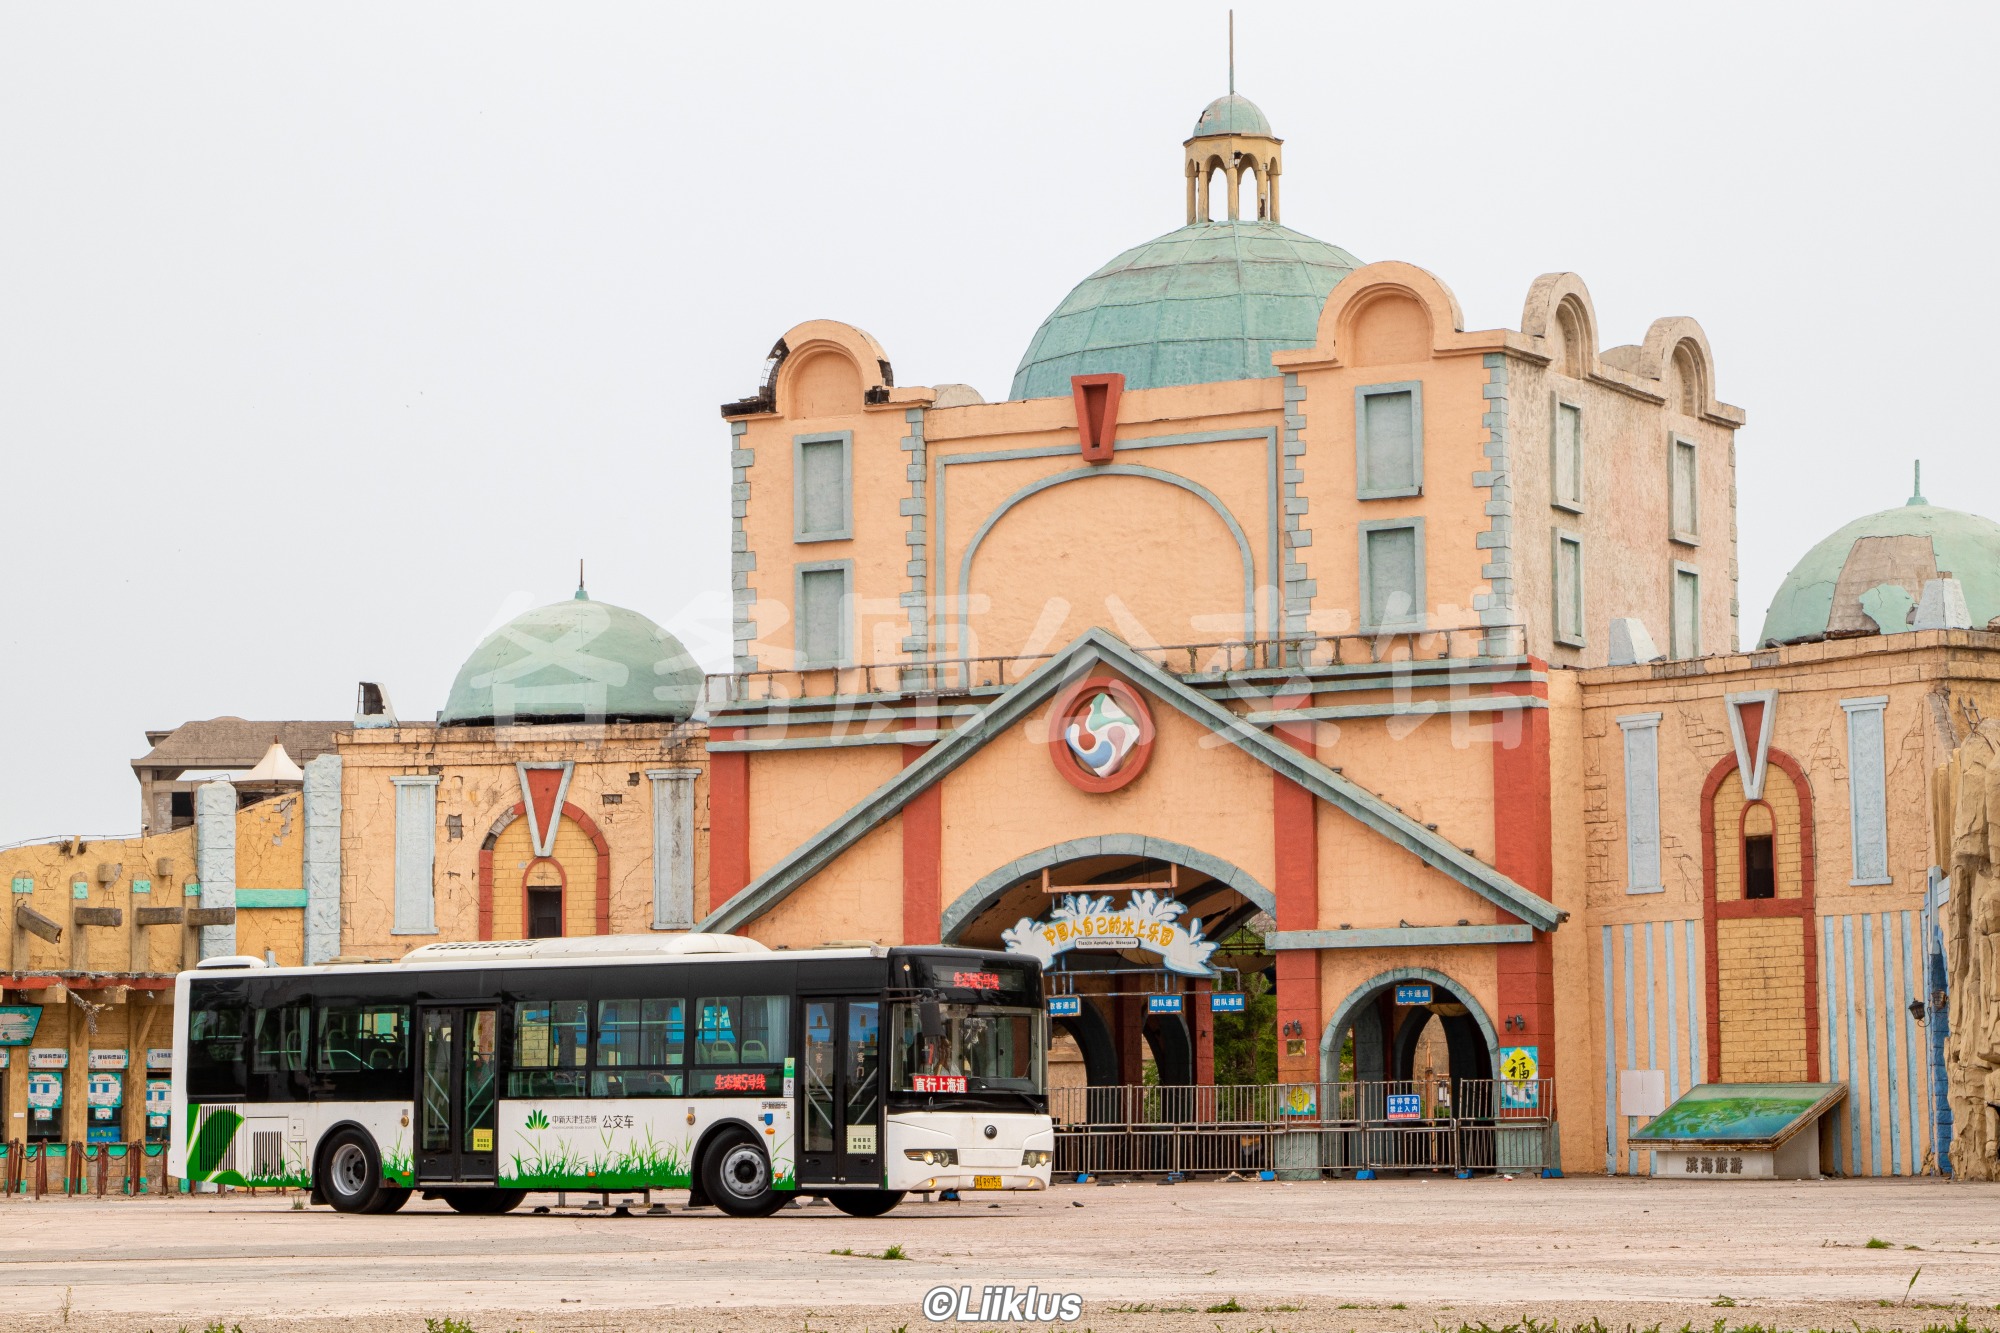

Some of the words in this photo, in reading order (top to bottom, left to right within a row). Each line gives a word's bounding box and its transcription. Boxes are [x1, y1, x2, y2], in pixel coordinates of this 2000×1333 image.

[1042, 915, 1175, 947] 中国人自己的水上乐园
[953, 971, 1000, 990] 生态城5号线
[1398, 989, 1429, 998] 年卡通道
[1151, 999, 1180, 1007] 团队通道
[1213, 998, 1243, 1006] 团队通道
[856, 1040, 865, 1078] 上客门
[1508, 1056, 1530, 1080] 福
[714, 1073, 767, 1091] 生态城5号线
[915, 1077, 966, 1093] 直行上海道
[1389, 1097, 1418, 1105] 暂停营业
[1389, 1105, 1418, 1113] 禁止入内
[552, 1115, 597, 1124] 中新天津生态城
[602, 1114, 634, 1129] 公交车
[1685, 1156, 1743, 1174] 滨海旅游
